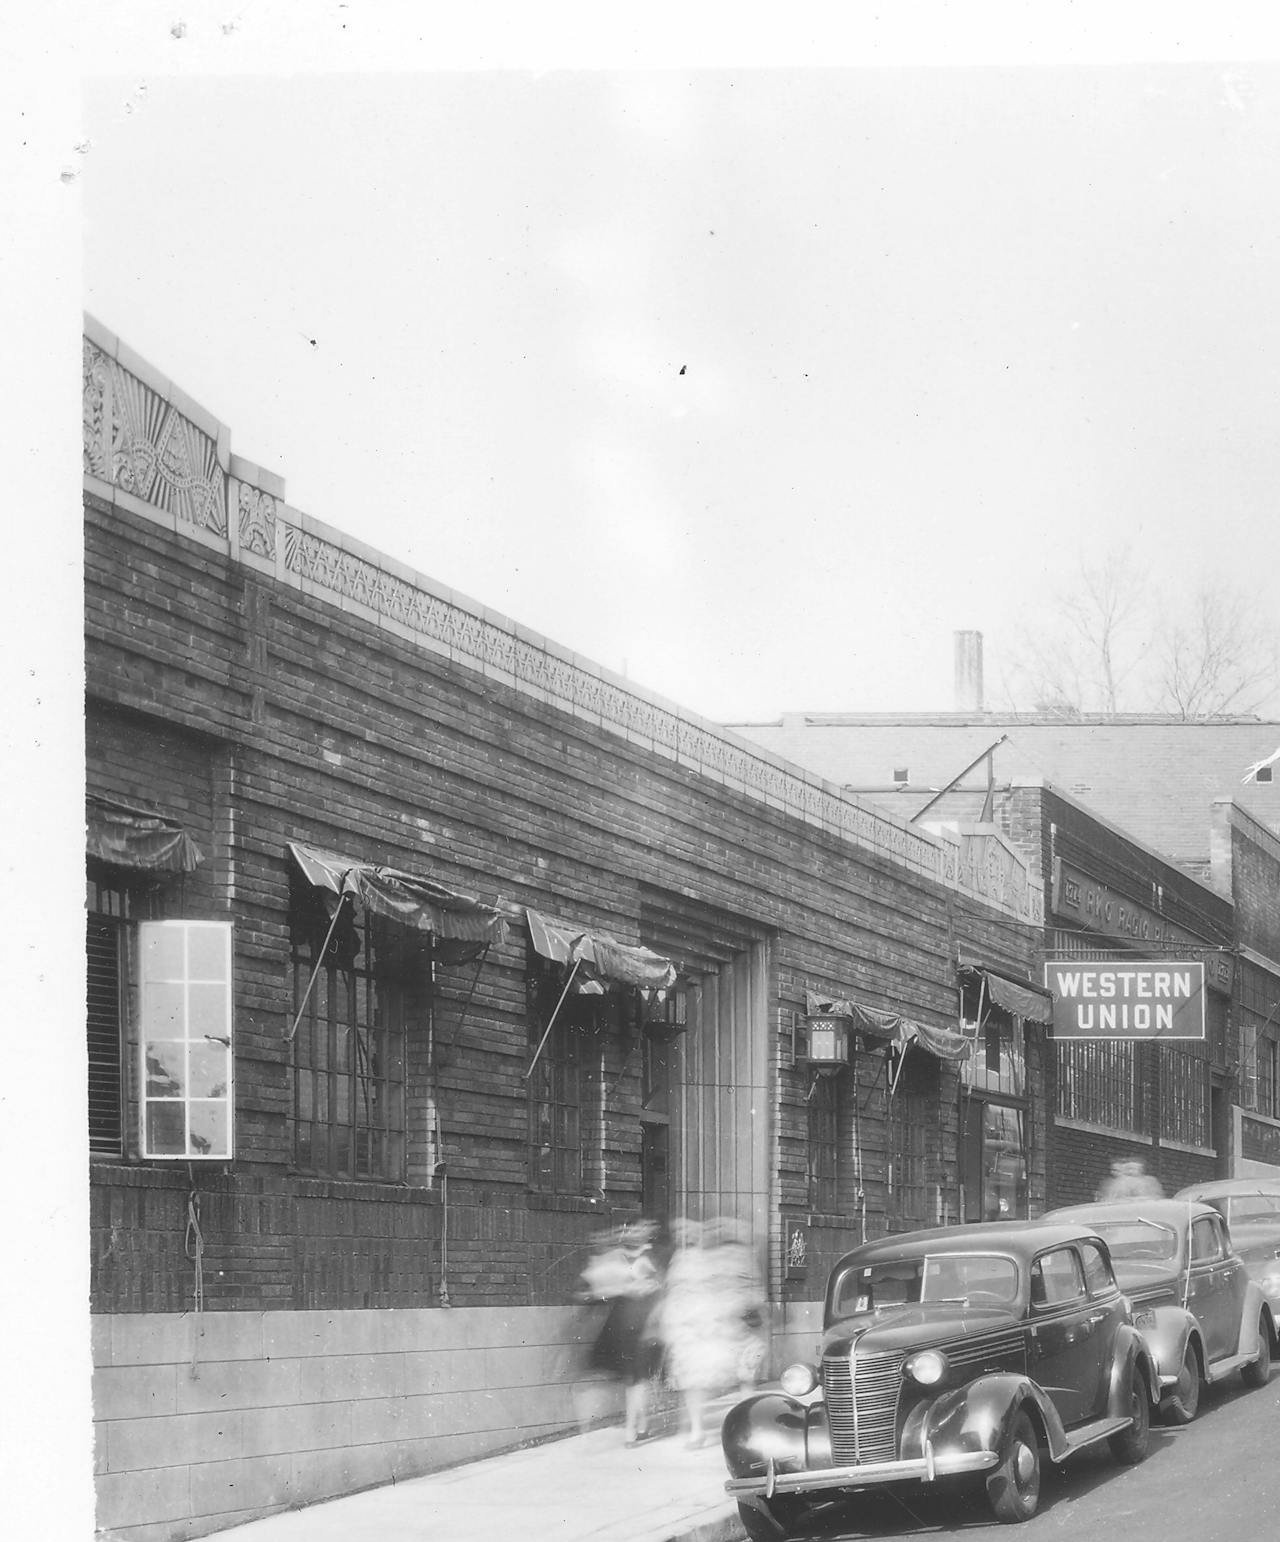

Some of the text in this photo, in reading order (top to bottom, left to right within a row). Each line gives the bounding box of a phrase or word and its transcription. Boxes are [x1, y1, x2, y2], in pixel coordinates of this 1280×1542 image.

[1086, 891, 1113, 923] RKO
[1118, 906, 1150, 938] RADIO
[1056, 971, 1192, 999] WESTERN
[1076, 1003, 1174, 1030] UNION
